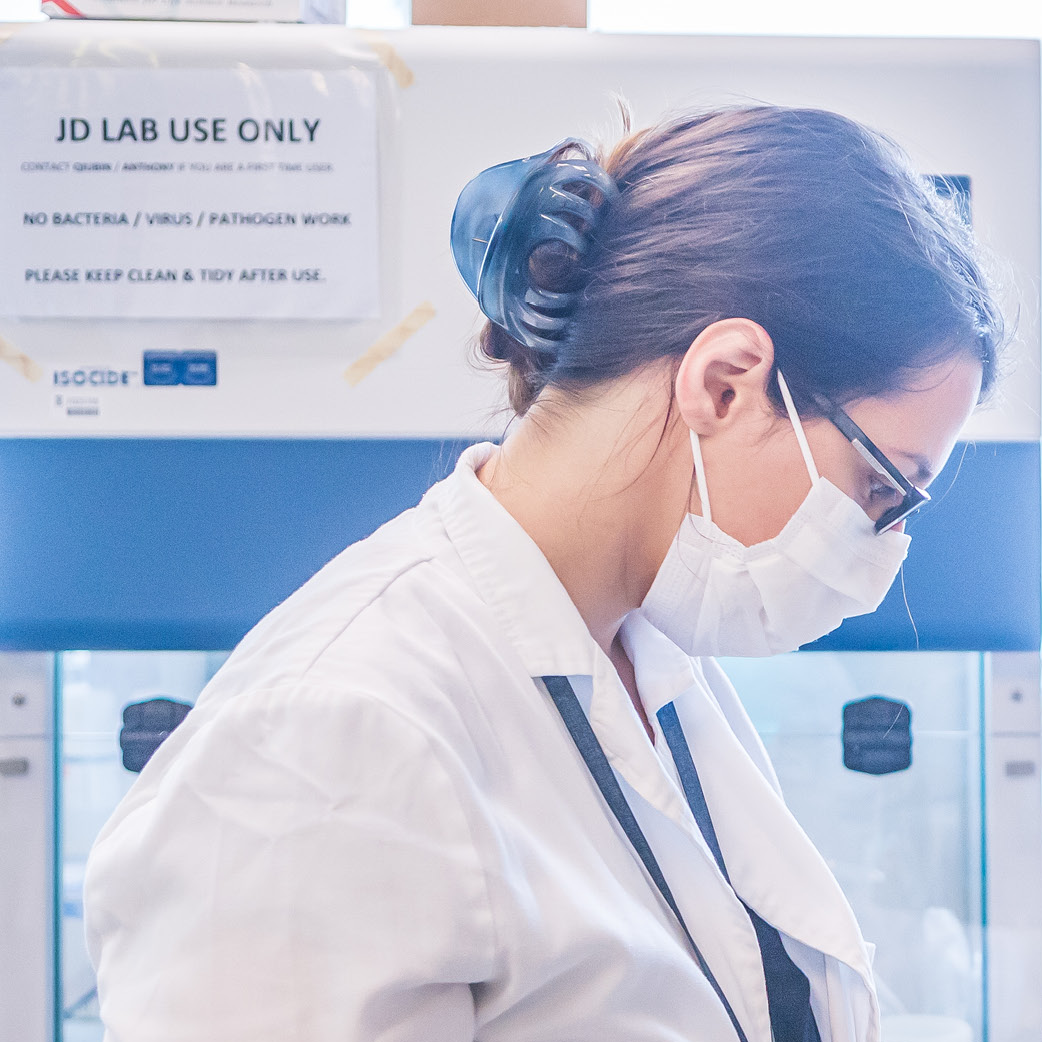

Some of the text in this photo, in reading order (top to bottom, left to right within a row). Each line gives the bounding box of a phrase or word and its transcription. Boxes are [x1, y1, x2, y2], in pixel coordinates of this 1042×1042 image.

[56, 117, 321, 142] JD LAB USE ONLY
[23, 212, 48, 226] NO
[52, 212, 130, 226] BACTERIA
[146, 212, 193, 226] VIRUS
[208, 212, 297, 226] PATHOGEN
[302, 212, 352, 226] WORK
[25, 268, 80, 283] PLEASE
[85, 268, 124, 283] KEEP
[127, 268, 178, 283] CLEAN
[182, 268, 195, 283] &
[200, 268, 235, 283] TIDY
[239, 268, 288, 283] AFTER
